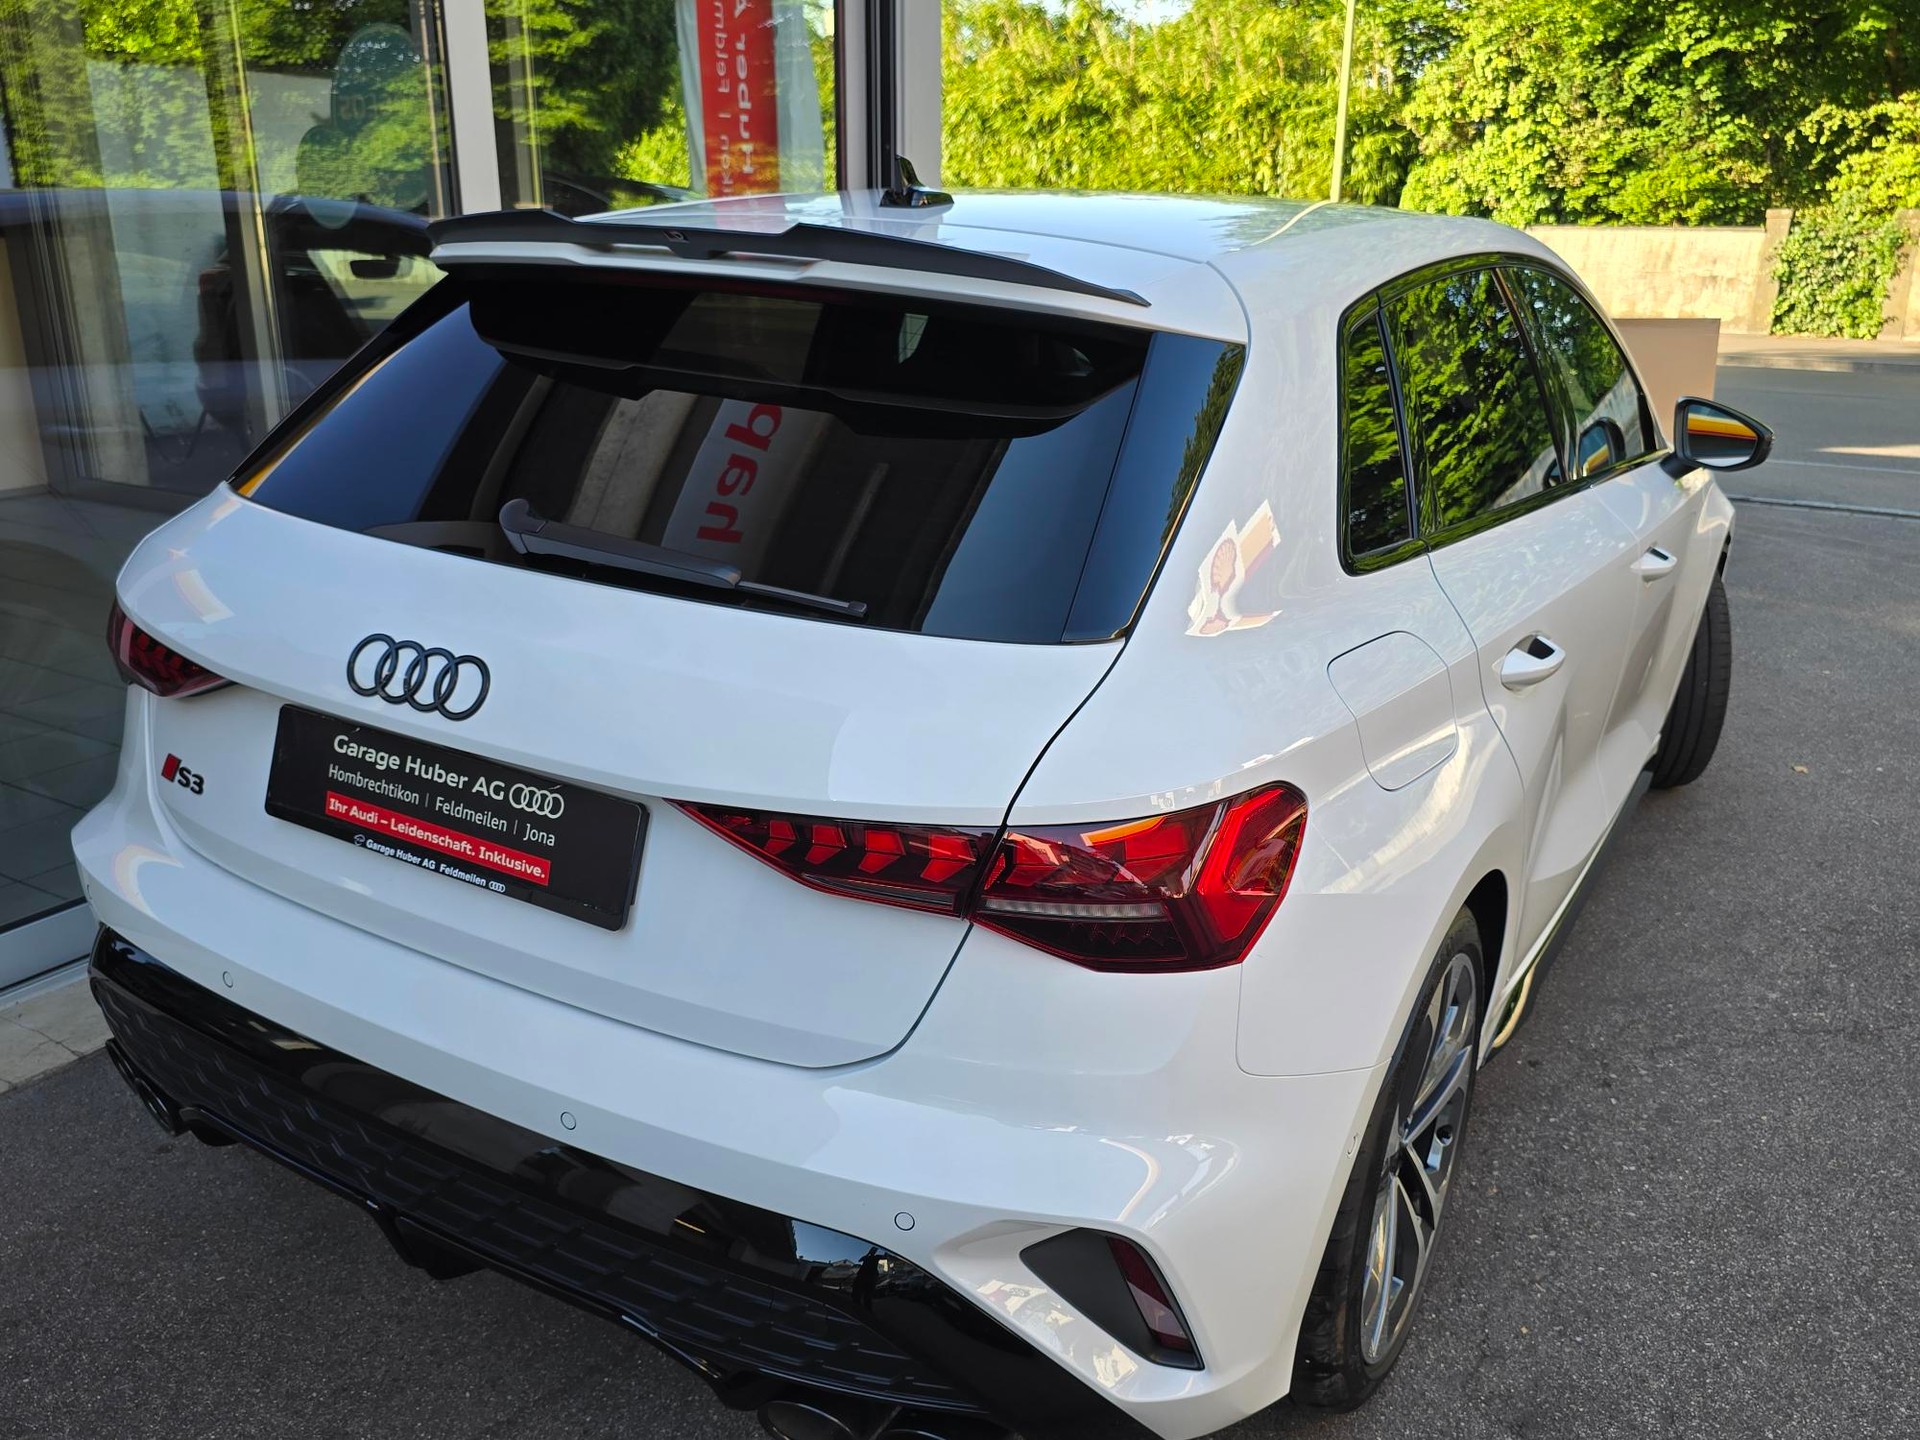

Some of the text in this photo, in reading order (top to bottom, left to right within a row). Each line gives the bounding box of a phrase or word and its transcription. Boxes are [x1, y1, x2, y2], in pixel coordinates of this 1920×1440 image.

[177, 766, 205, 796] S3
[333, 734, 506, 801] Garage Huber AG
[328, 763, 420, 805] Hombrechtikon
[435, 796, 507, 832] Feldmeilen
[523, 823, 556, 847] Jona
[329, 798, 348, 813] Ihr
[349, 805, 379, 825] Audi
[390, 818, 475, 856] Leidenschaft.
[479, 846, 546, 879] Inklusive.
[366, 839, 487, 887] Garage Huber AG Feldmeilen
